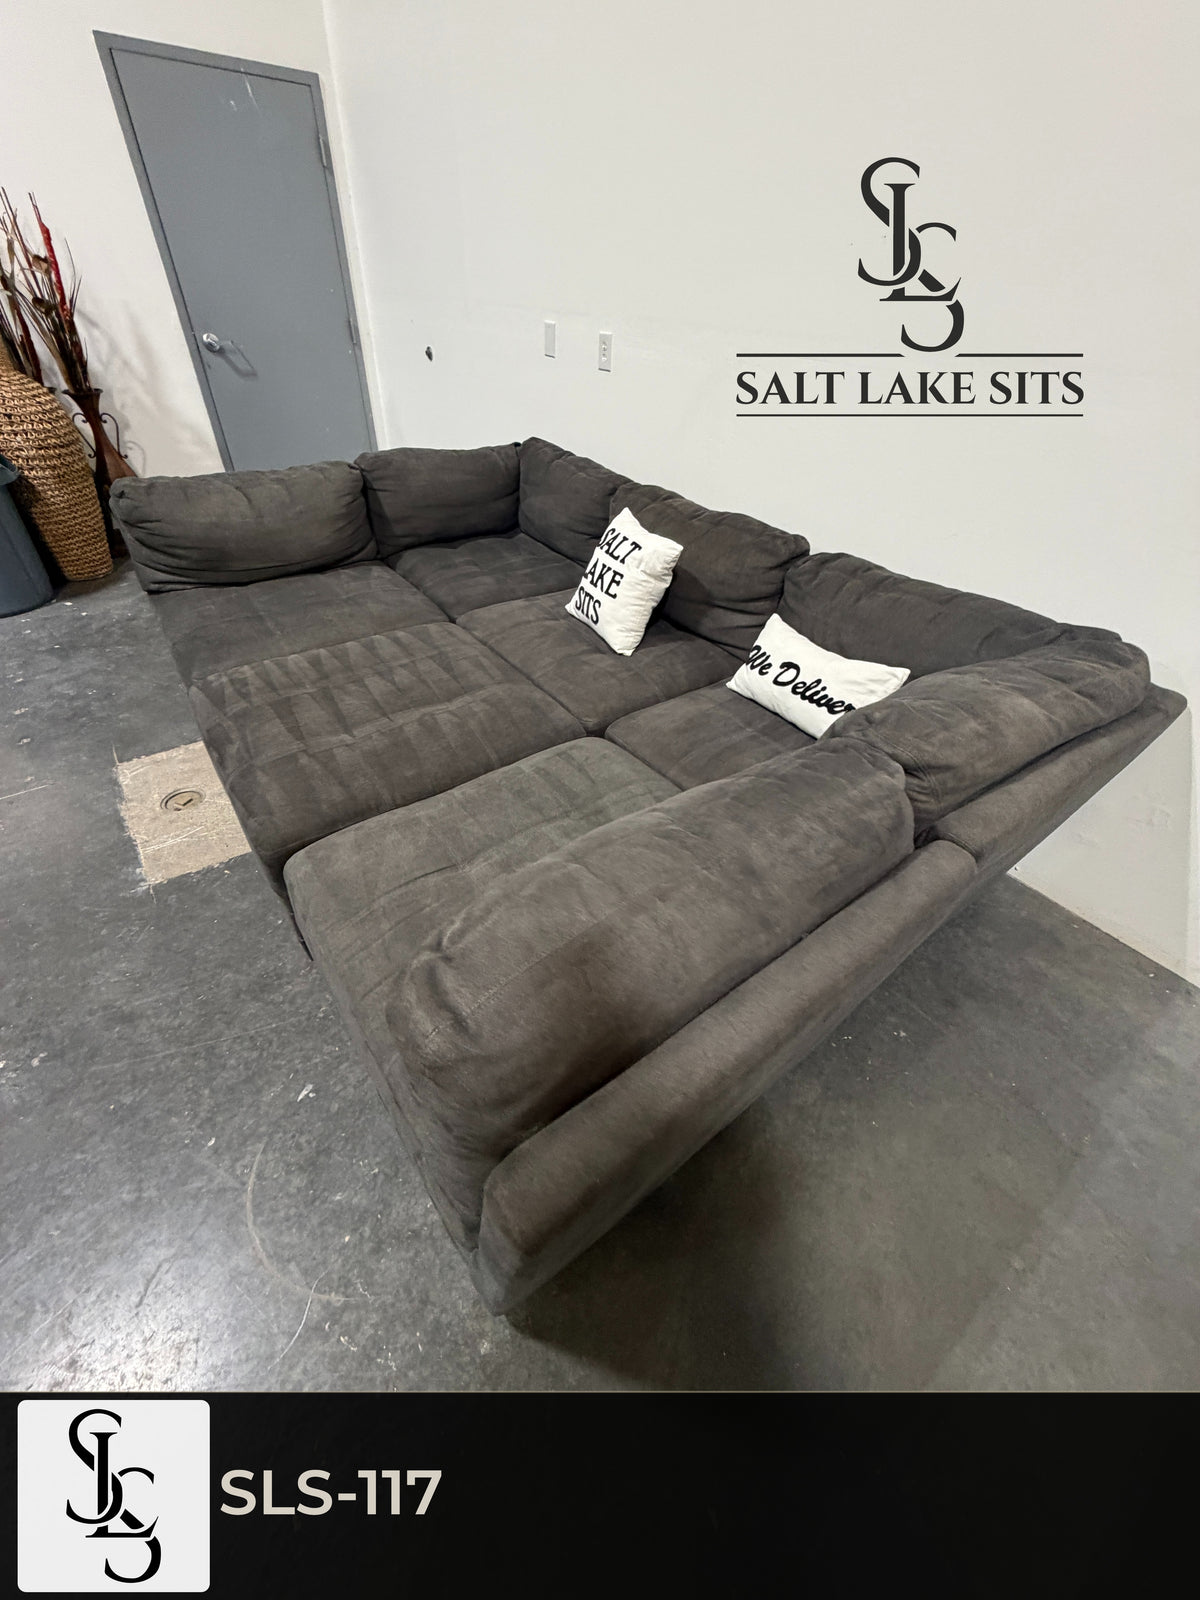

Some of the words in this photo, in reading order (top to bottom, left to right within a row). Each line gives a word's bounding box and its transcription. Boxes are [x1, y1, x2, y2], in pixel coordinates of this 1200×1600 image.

[597, 528, 642, 564] SALT
[583, 558, 624, 599] AKE
[575, 586, 601, 625] SITS
[745, 645, 773, 676] We
